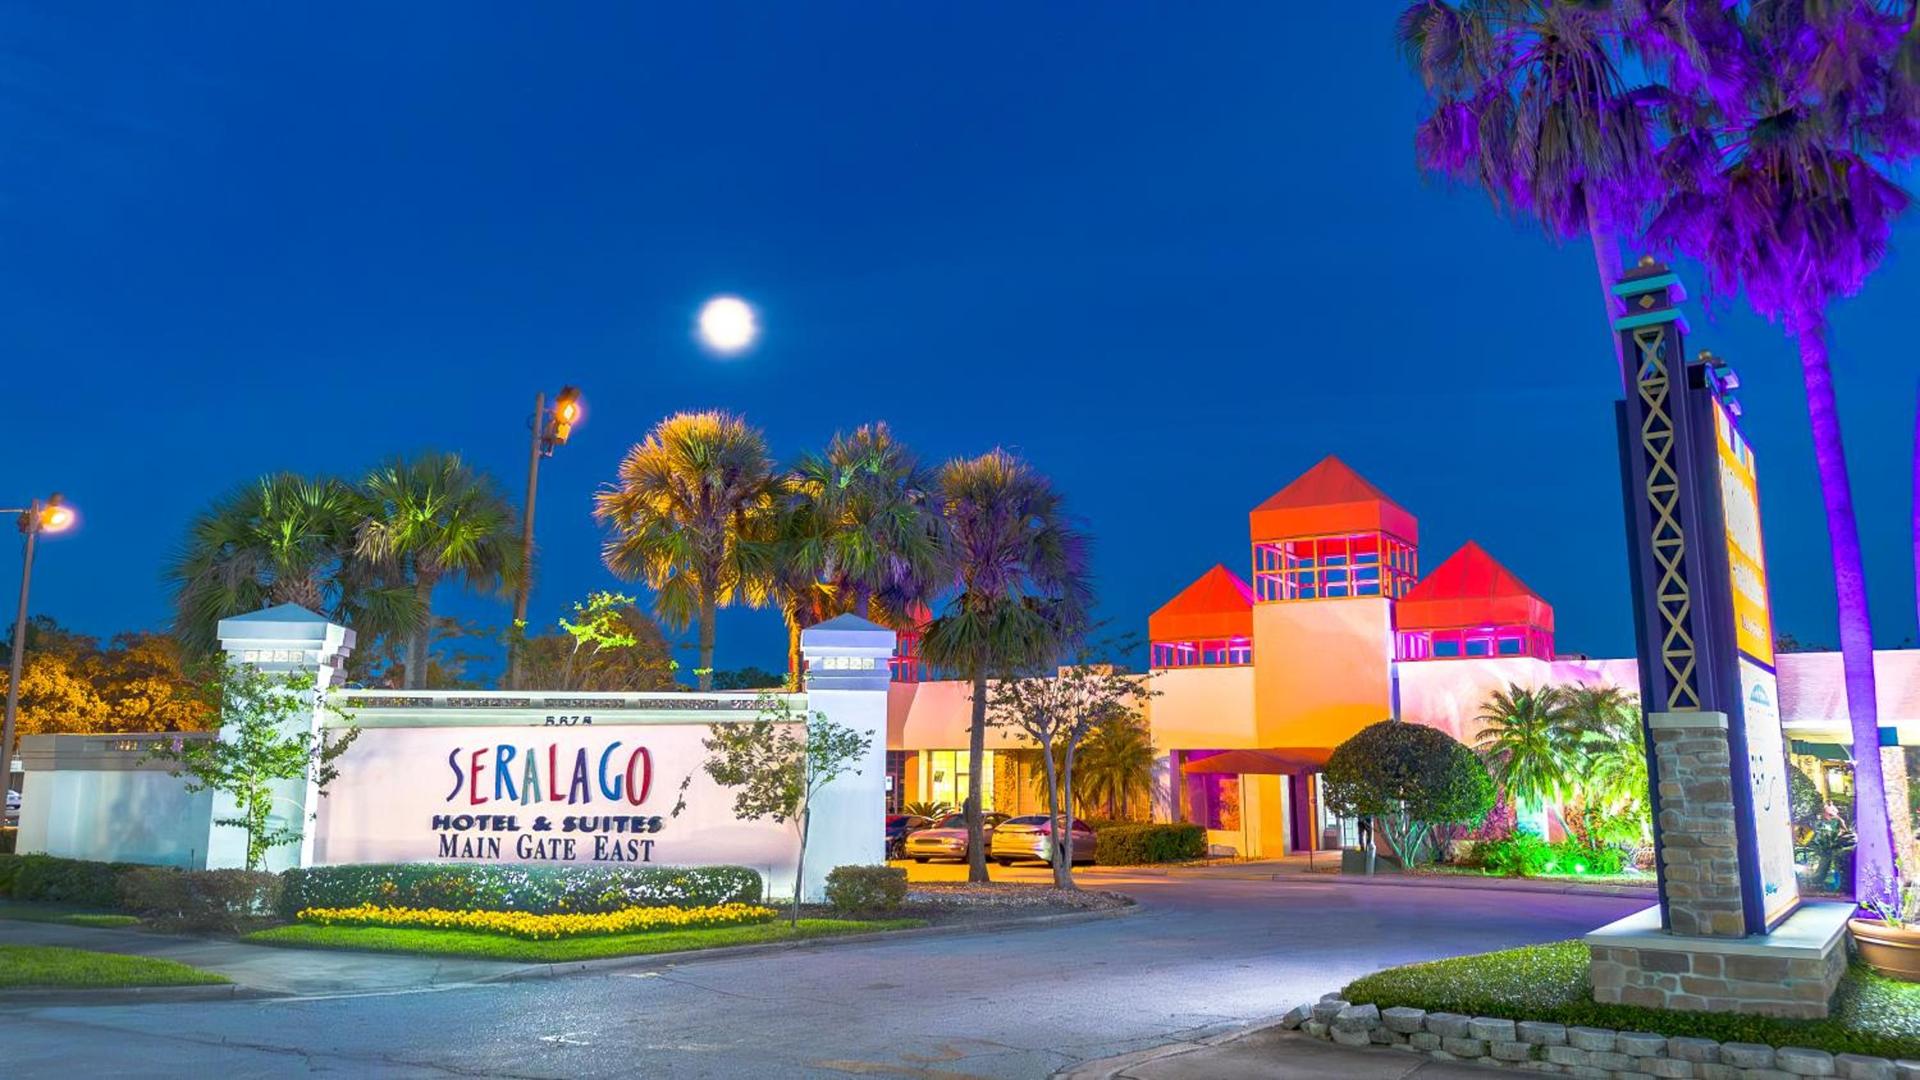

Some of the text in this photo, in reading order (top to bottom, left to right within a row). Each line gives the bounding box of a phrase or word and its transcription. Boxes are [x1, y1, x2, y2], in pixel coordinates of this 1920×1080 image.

[446, 741, 653, 806] SERALAGO
[432, 815, 664, 833] HOTEL & SUITES
[438, 833, 655, 862] MAIN GATE EAST
